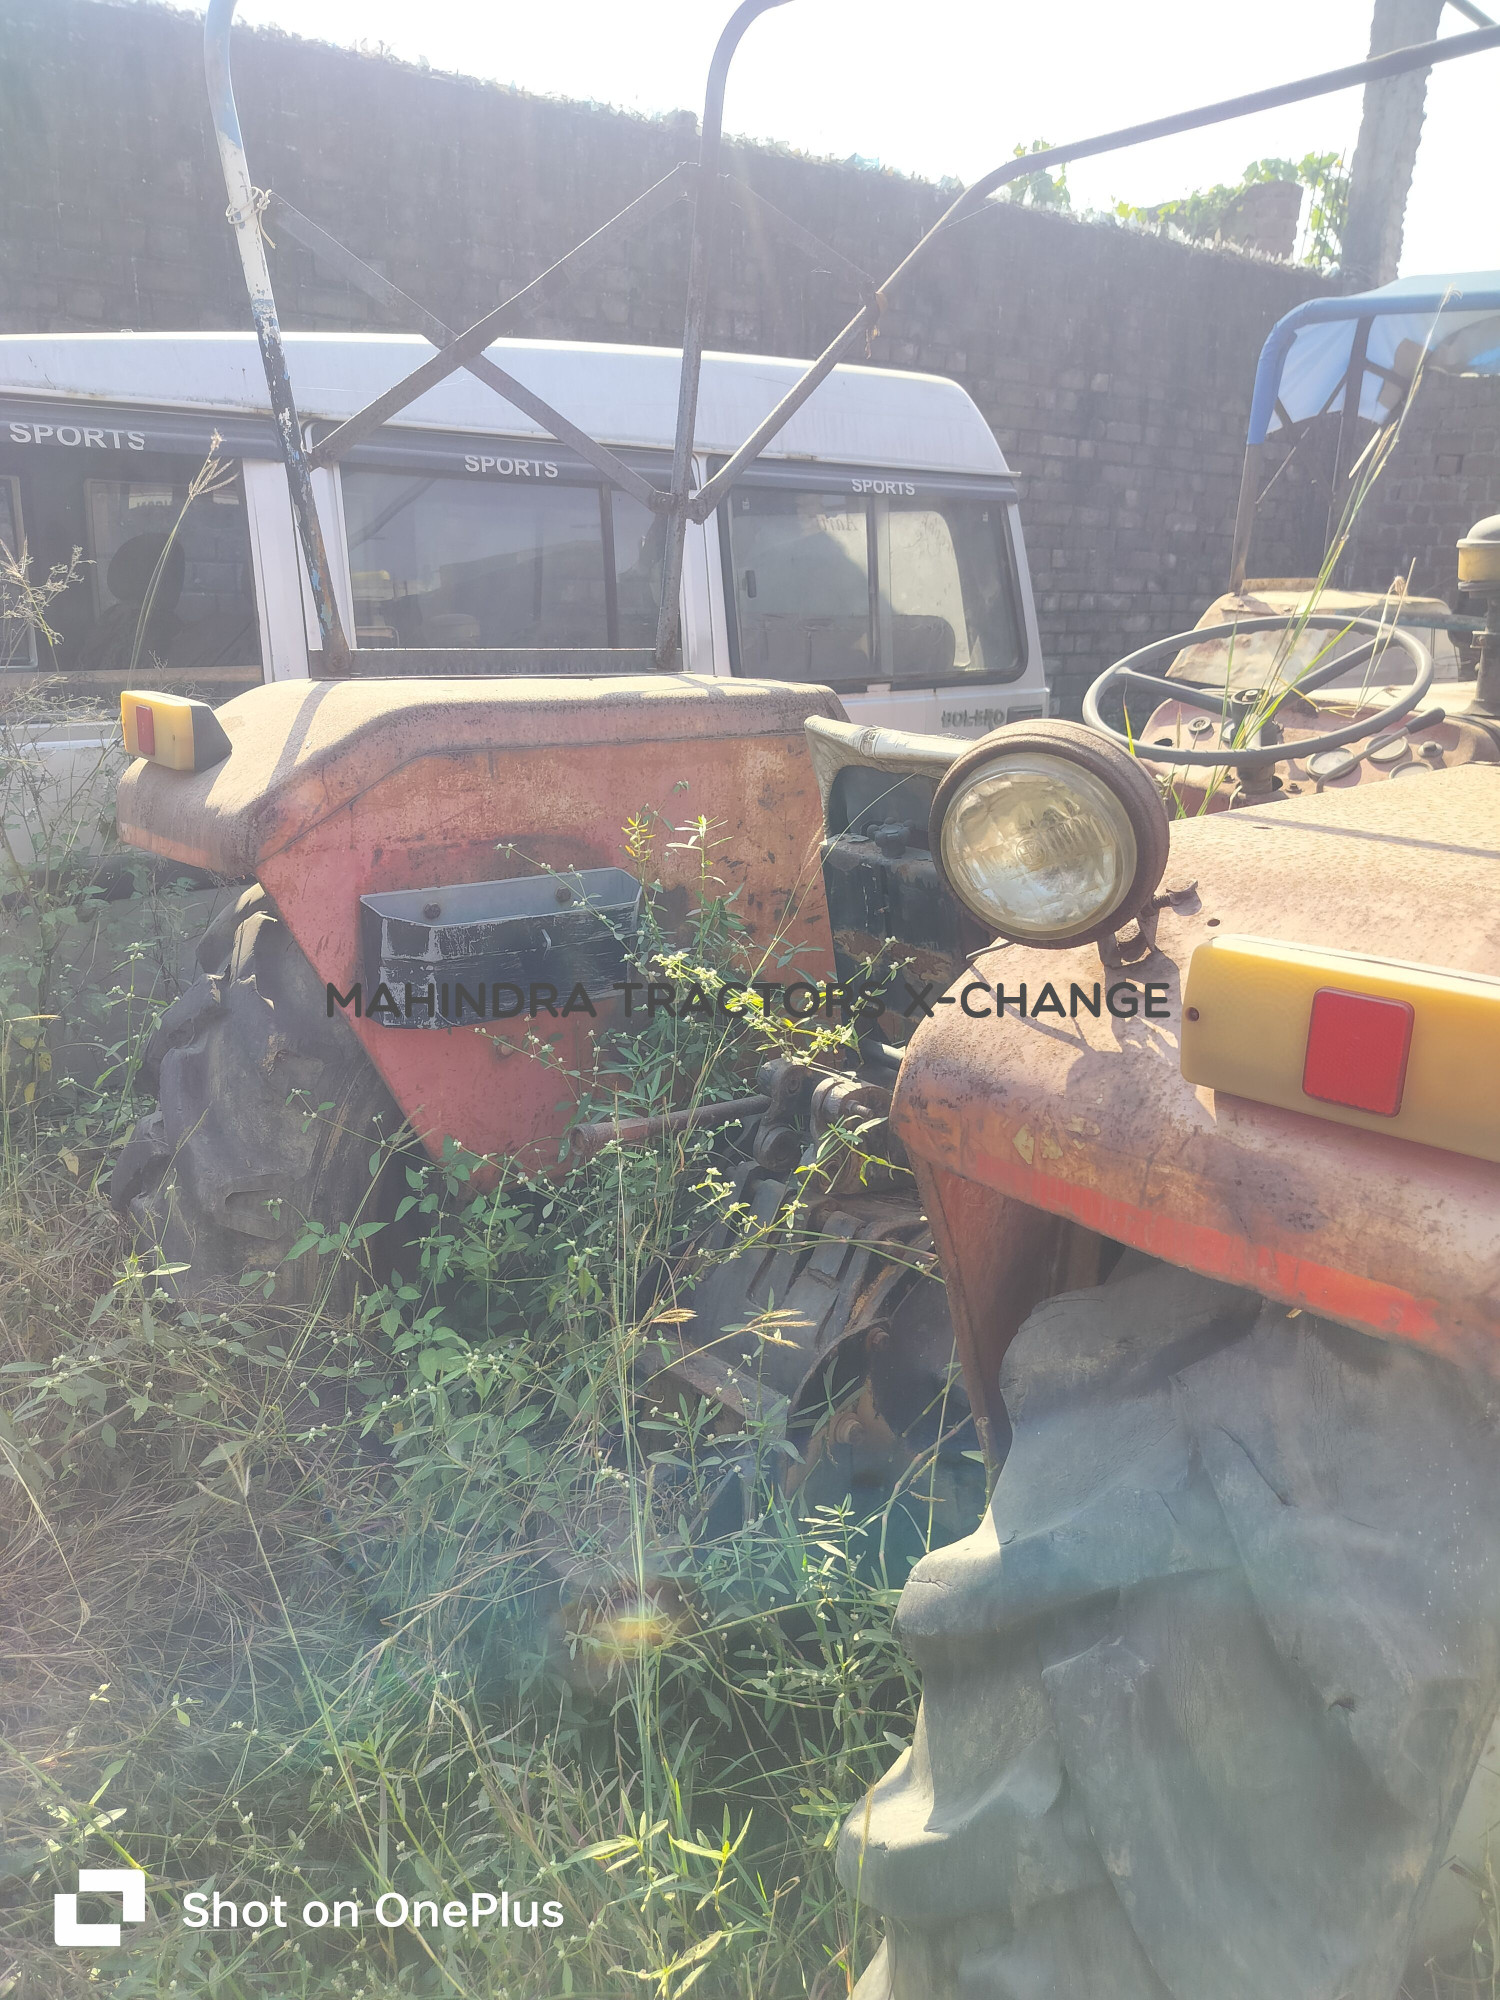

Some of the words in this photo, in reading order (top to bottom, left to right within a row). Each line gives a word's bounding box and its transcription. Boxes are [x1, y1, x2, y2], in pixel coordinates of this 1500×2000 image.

[9, 422, 145, 451] SPORTS
[464, 454, 559, 478] SPORTS
[851, 479, 916, 496] SPORTS
